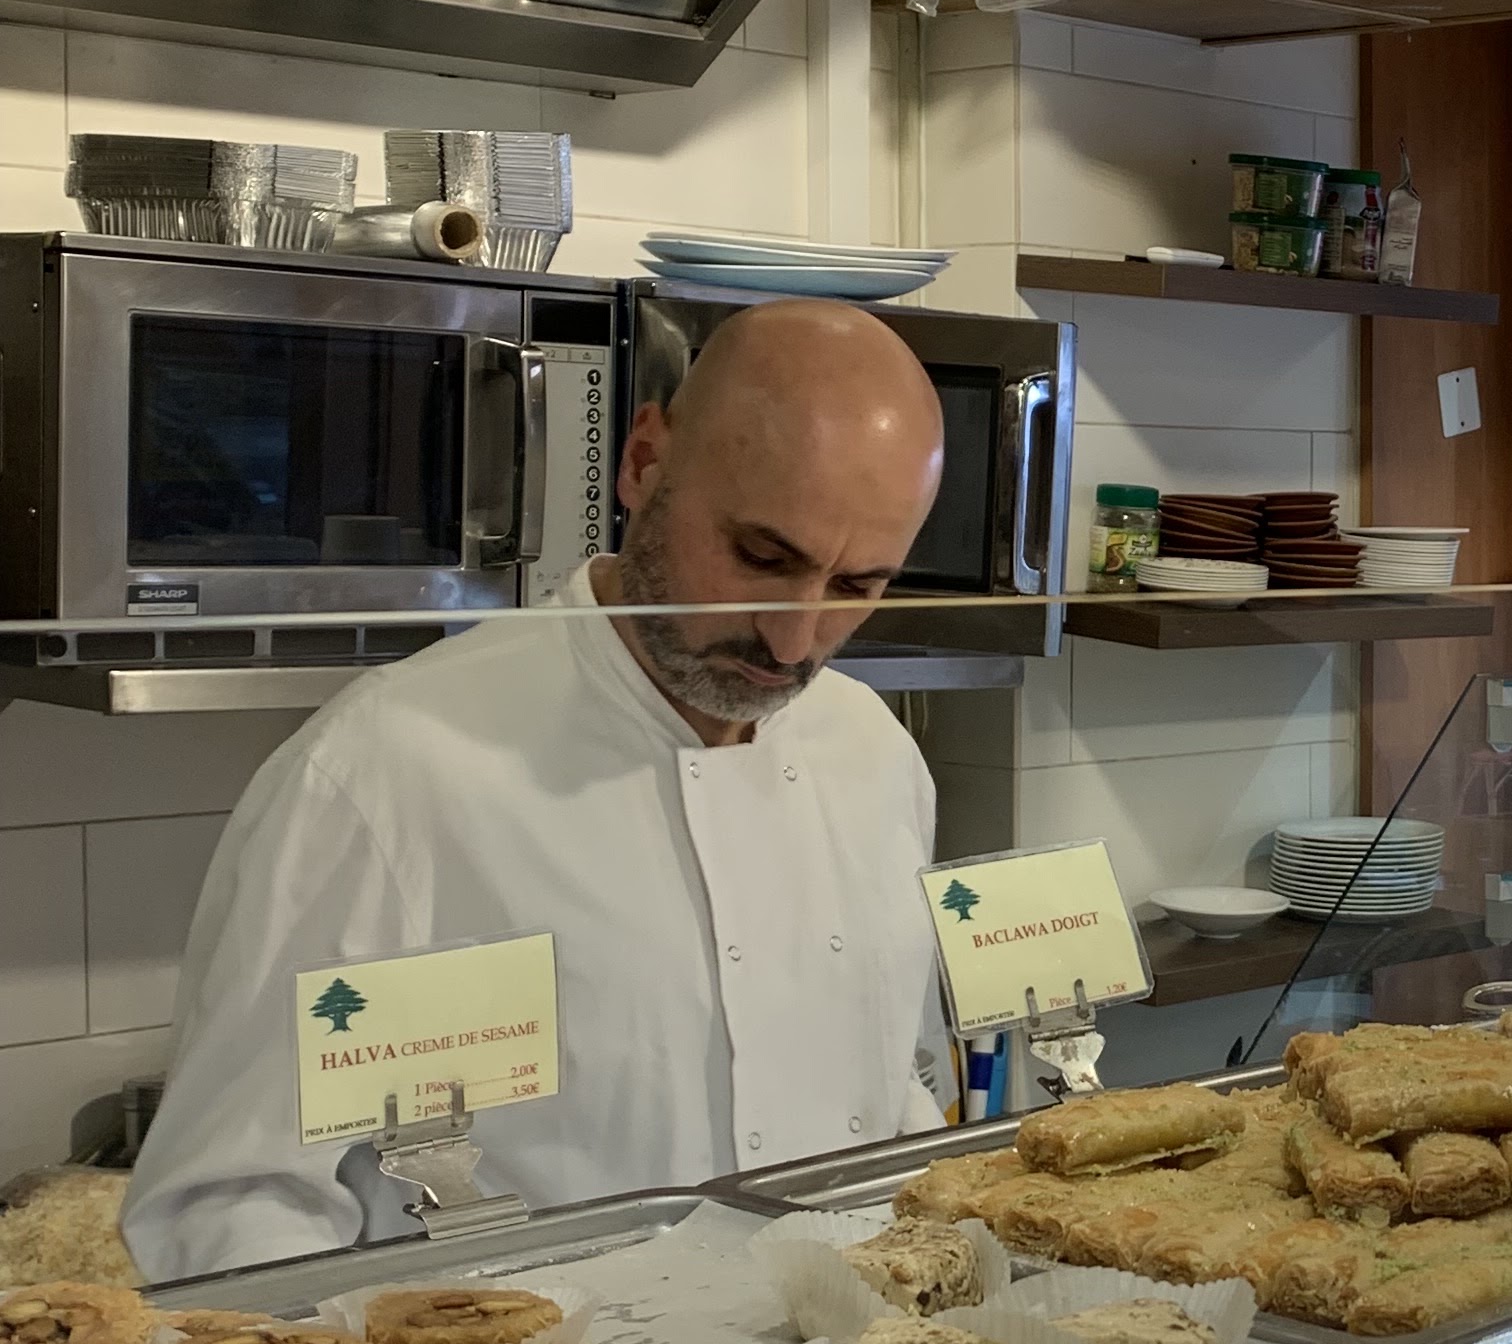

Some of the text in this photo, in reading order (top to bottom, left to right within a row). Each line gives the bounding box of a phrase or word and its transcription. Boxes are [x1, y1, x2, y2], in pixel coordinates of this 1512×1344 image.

[591, 373, 597, 382] 1
[590, 392, 599, 402] 2
[590, 412, 598, 421] 3
[589, 431, 598, 440] 4
[590, 450, 597, 459] 5
[589, 469, 597, 479] 6
[590, 489, 597, 497] 7
[589, 508, 597, 517] 8
[589, 527, 597, 536] 9
[139, 590, 187, 598] SHARP
[972, 911, 1099, 948] BACLAWA DOIGT
[321, 1020, 539, 1071] HALVA CREME DE SESAME
[305, 1117, 377, 1137] PRIX À EMPORTER
